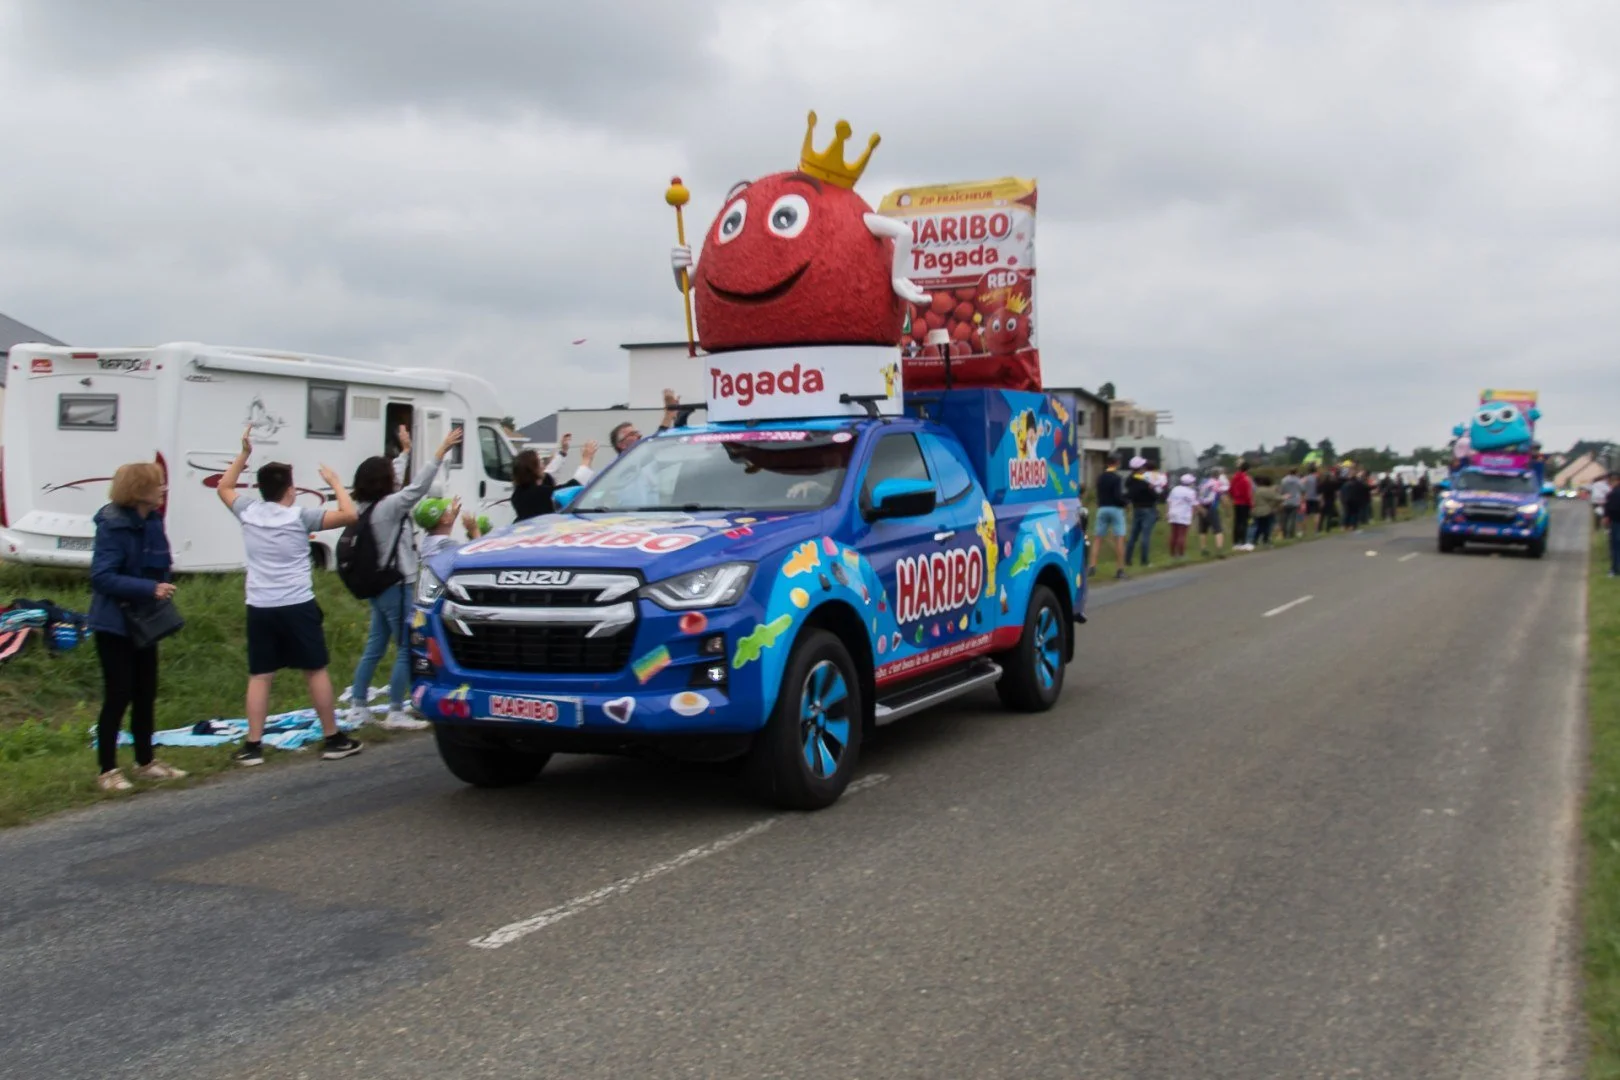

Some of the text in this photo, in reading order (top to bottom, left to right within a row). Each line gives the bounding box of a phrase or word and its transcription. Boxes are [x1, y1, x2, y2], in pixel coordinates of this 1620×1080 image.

[910, 244, 999, 275] Tagada
[987, 272, 1018, 289] RED
[710, 363, 824, 406] Tagada
[1009, 458, 1048, 490] HARIBO
[498, 570, 571, 585] ISUZU
[896, 545, 983, 624] HARIBO
[489, 695, 559, 723] HARIBO
